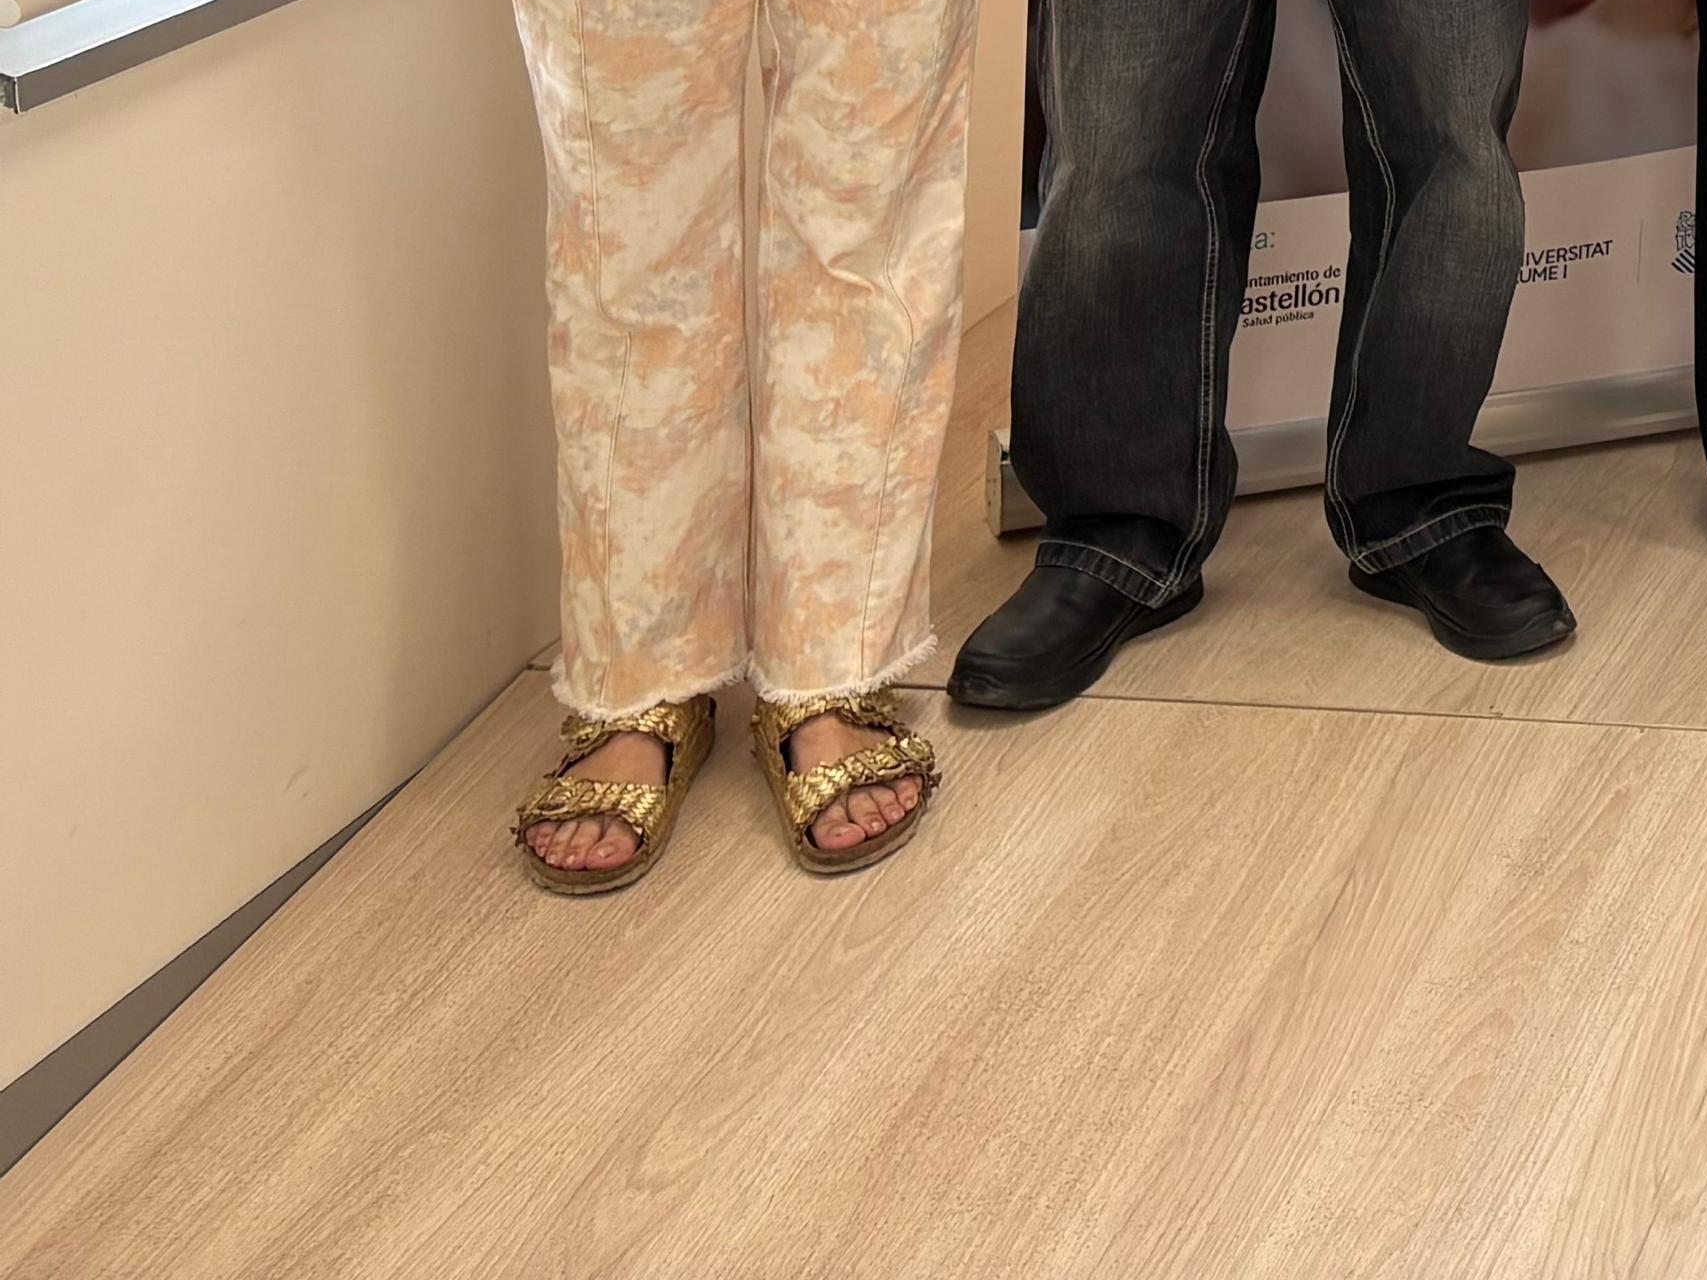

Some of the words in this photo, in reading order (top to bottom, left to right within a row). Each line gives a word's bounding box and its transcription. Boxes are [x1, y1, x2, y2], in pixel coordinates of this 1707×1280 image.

[1524, 239, 1614, 267] IVERSITAT
[1323, 264, 1342, 280] de
[1517, 264, 1560, 284] UME
[1240, 282, 1341, 315] astellón
